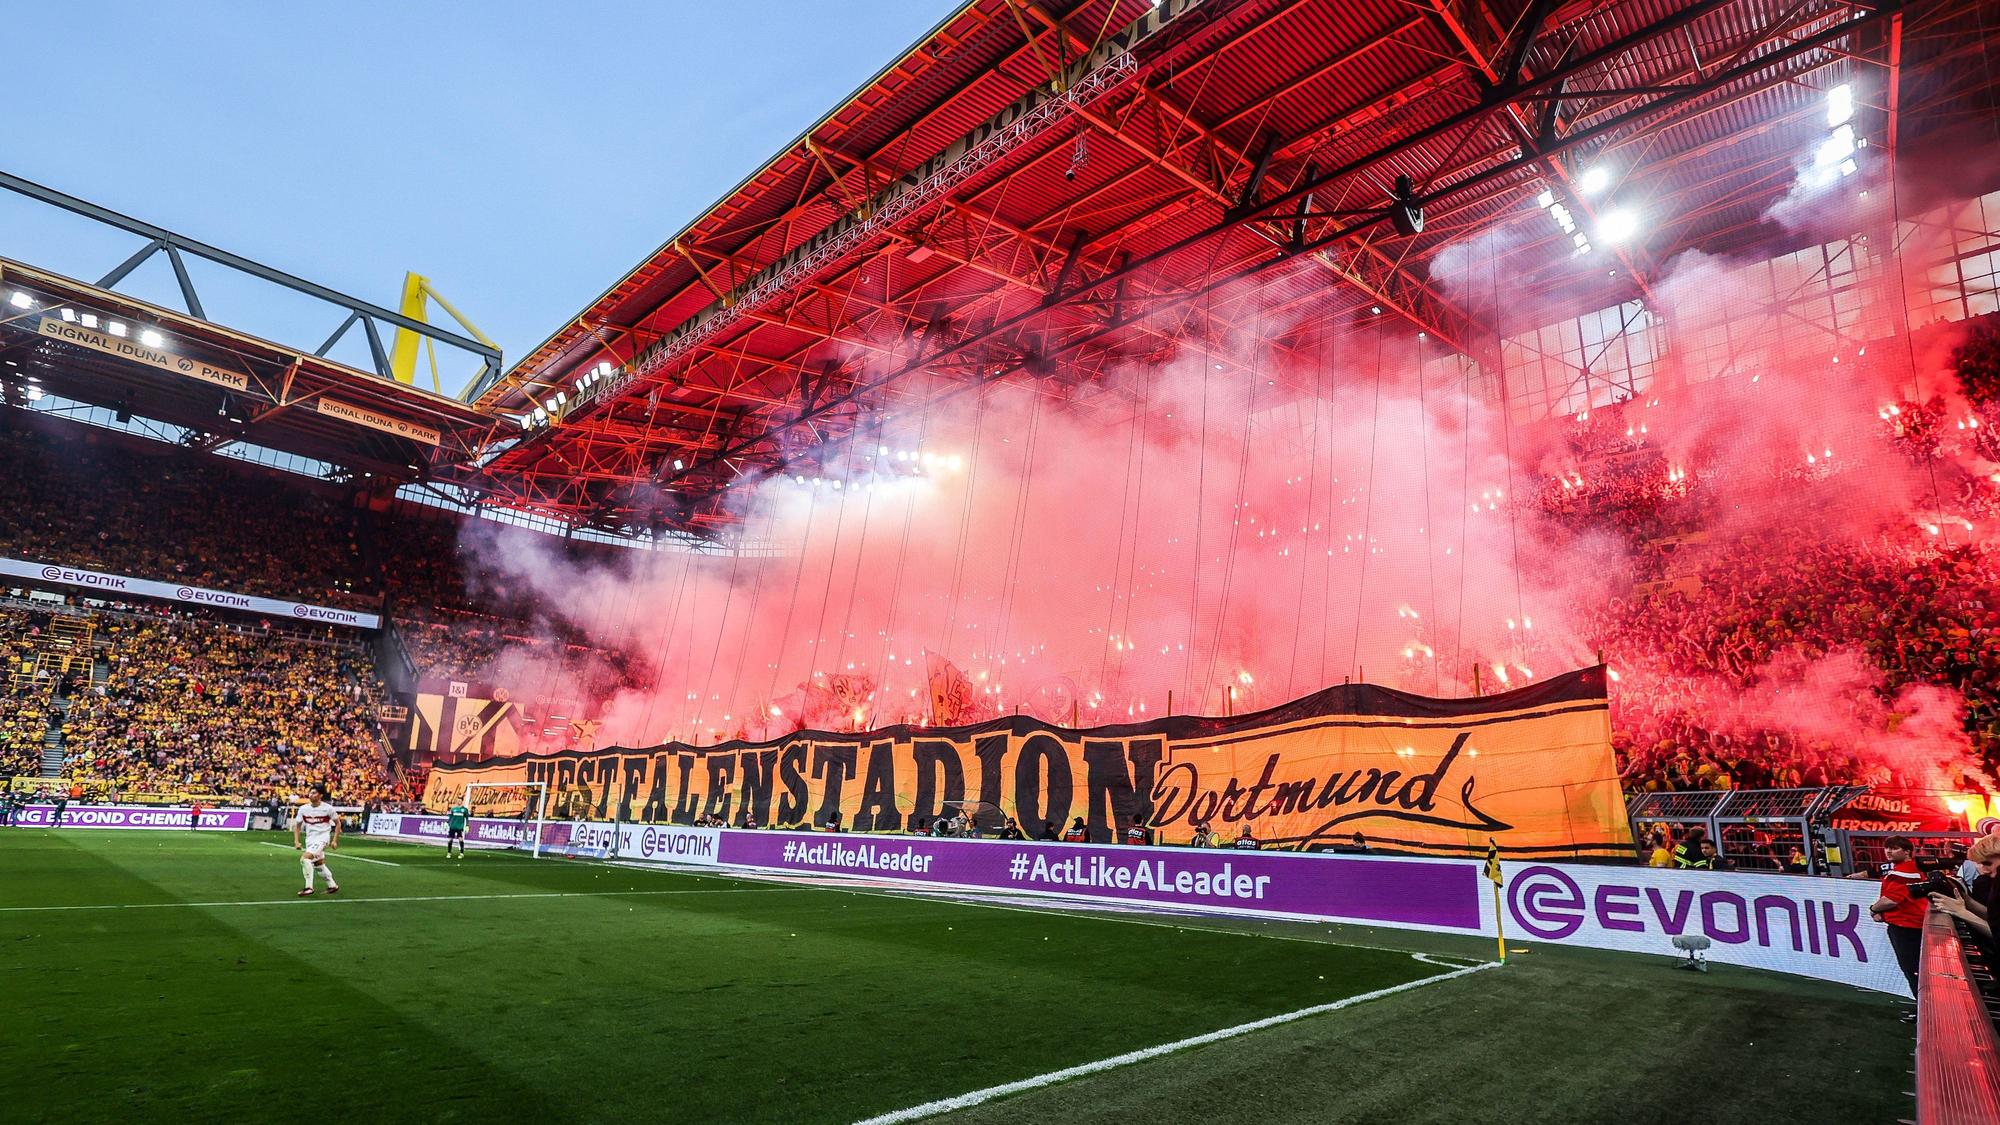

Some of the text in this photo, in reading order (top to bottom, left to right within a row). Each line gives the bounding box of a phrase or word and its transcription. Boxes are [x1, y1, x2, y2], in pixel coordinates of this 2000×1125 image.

[45, 322, 244, 387] SIGNAL IDUNA PARK
[323, 402, 436, 441] SIGNAL IDUNA PARK
[63, 571, 127, 589] EVONIK
[195, 590, 250, 608] EVONIK
[309, 608, 358, 624] EVONIK
[460, 716, 480, 731] BVB
[526, 734, 1163, 844] WESTFALENSTADION
[1151, 732, 1471, 829] Dortmund
[46, 811, 125, 824] BEYOND
[128, 812, 230, 826] CHEMISTRY
[587, 828, 632, 850] EVONIK
[657, 833, 713, 857] EVONIK
[782, 840, 933, 873] #ActLikeALeader
[1009, 852, 1271, 900] #ActLikeALeader
[1594, 883, 1869, 963] EVONIK
